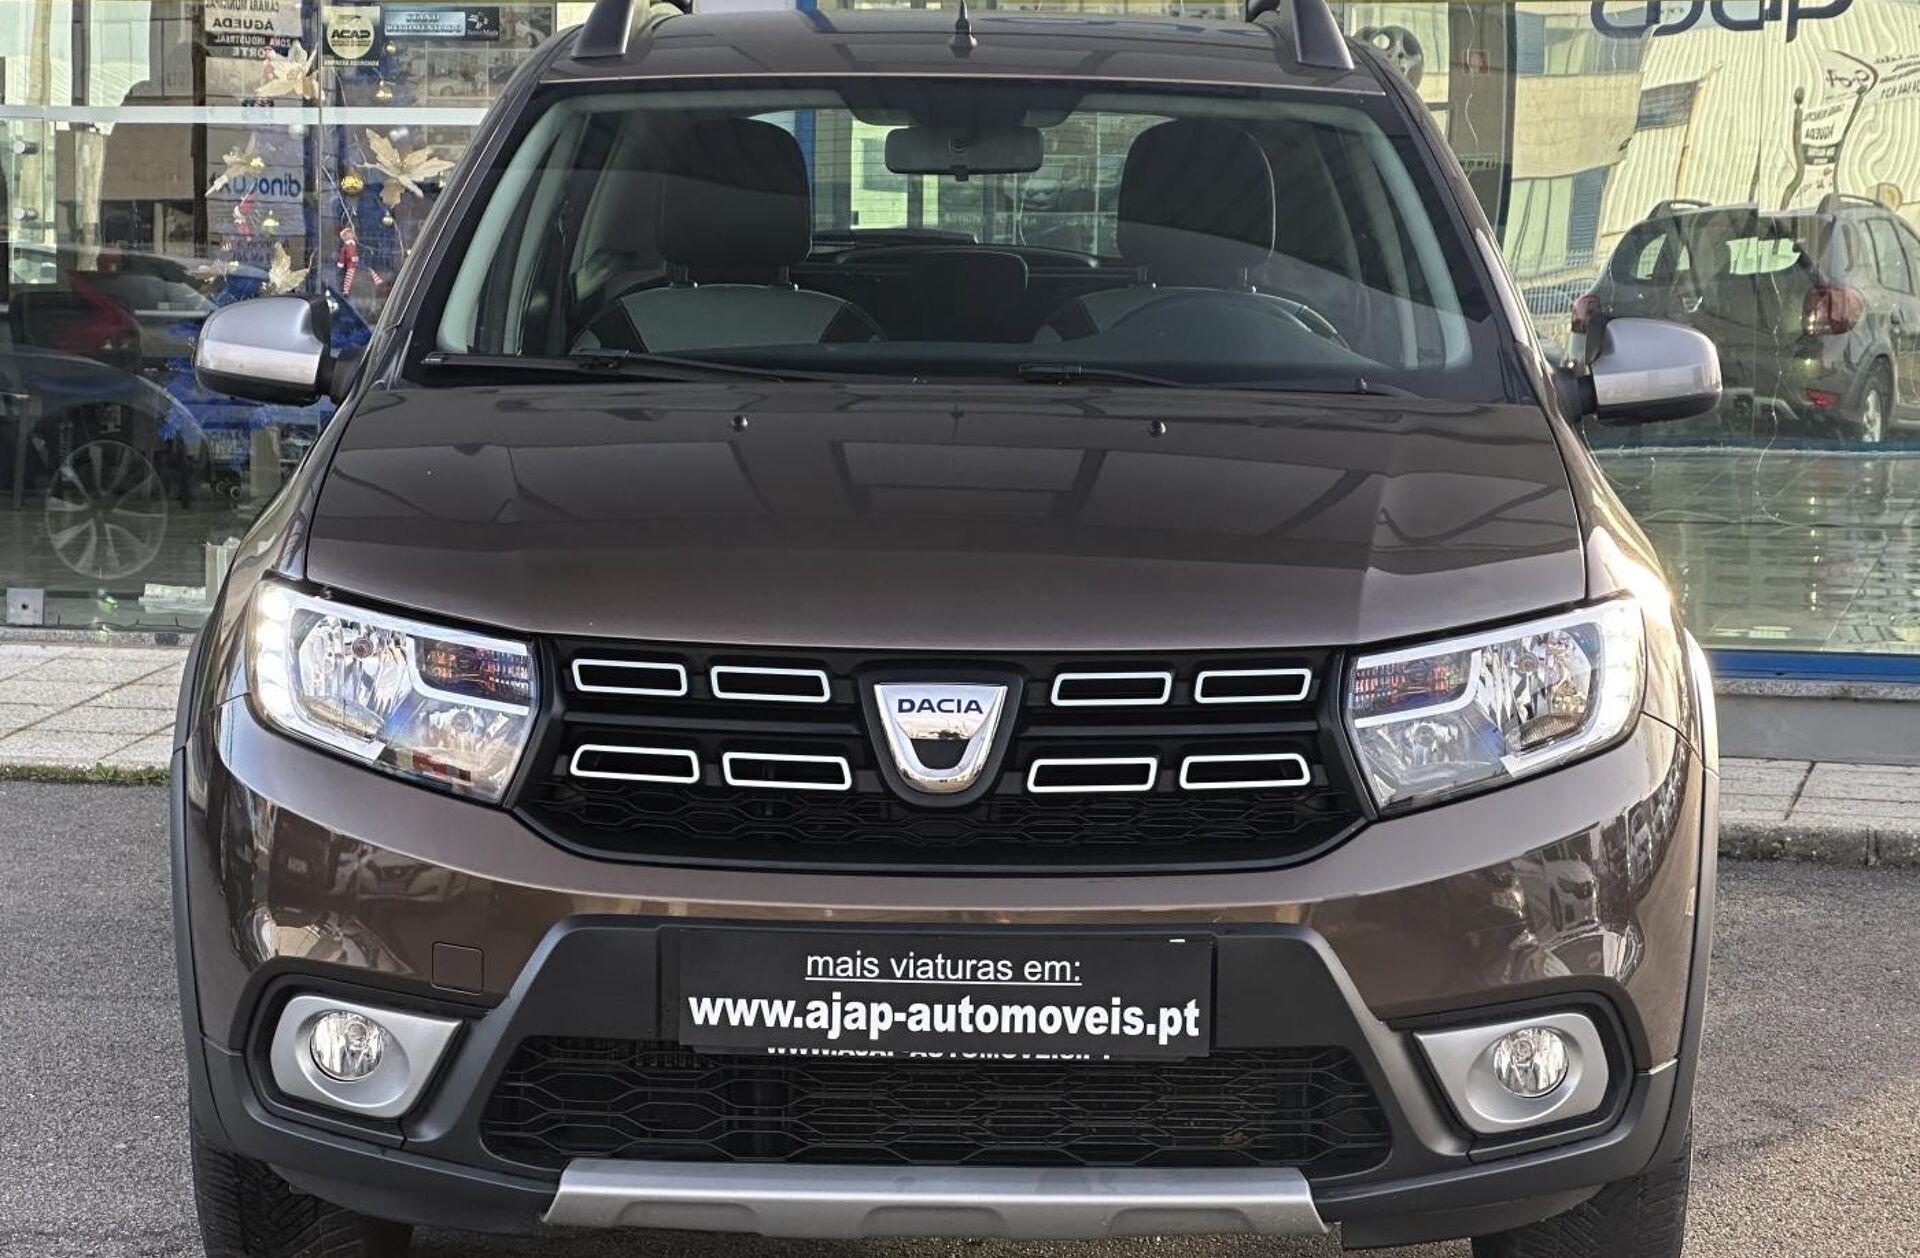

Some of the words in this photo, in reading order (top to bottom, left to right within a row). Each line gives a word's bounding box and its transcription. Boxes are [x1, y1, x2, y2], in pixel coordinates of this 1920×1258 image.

[897, 698, 984, 715] DACIA
[806, 950, 880, 980] mais
[892, 952, 1014, 983] viaturas
[1022, 954, 1082, 983] em:
[687, 992, 1201, 1046] www.ajap-automoveis.pt
